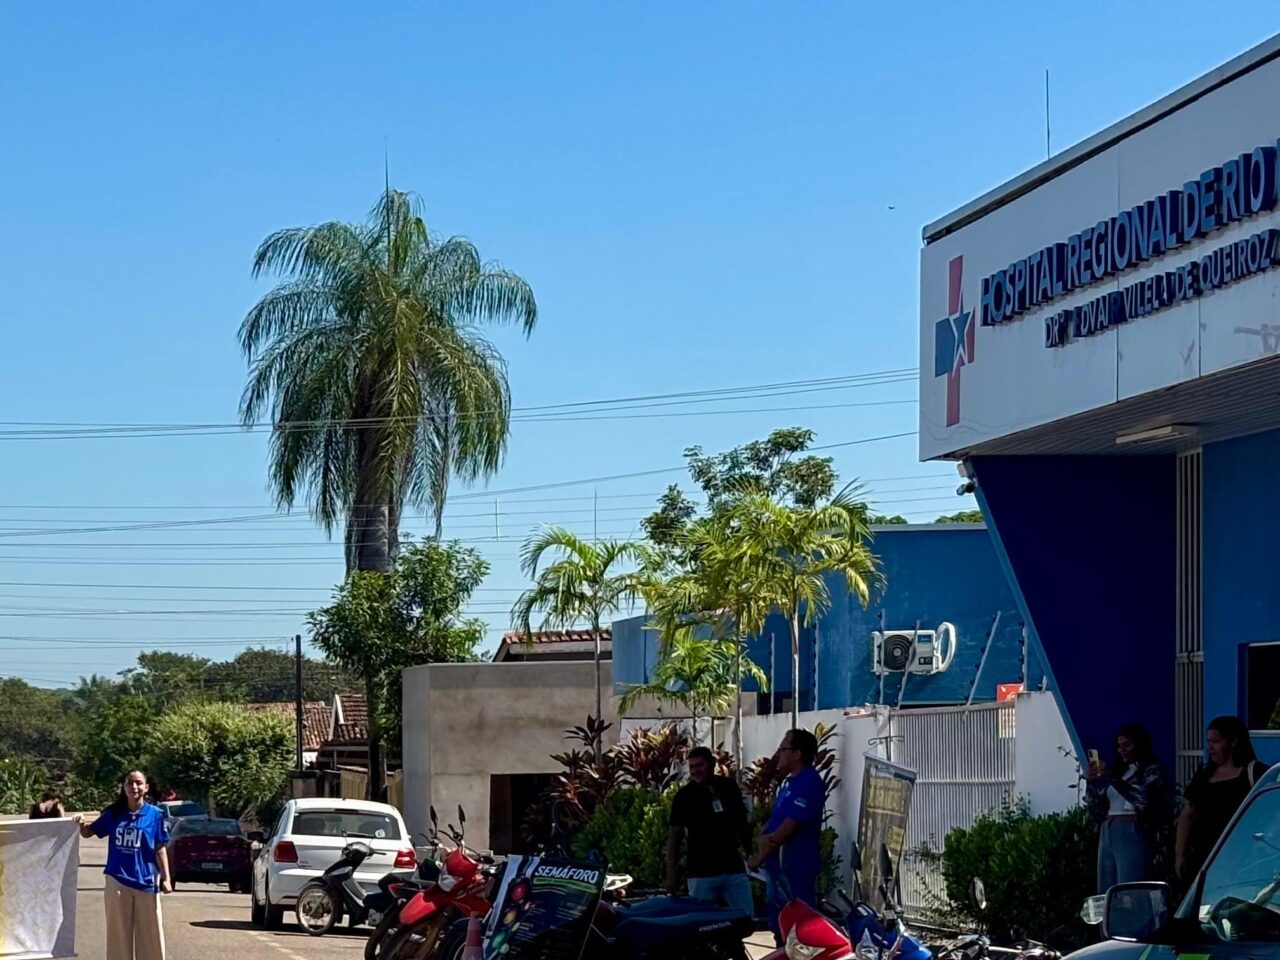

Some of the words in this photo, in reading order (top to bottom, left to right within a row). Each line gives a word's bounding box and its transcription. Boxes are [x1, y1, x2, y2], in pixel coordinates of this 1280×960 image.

[980, 242, 1068, 327] HOSPITAL
[1067, 189, 1183, 290] REGIONAL
[1182, 167, 1223, 242] DE
[1222, 146, 1276, 224] RIO
[1123, 271, 1174, 319] VILELA
[1175, 261, 1200, 300] DE
[1199, 229, 1274, 289] QUEIROZ
[534, 865, 600, 884] SEMÁFORO
